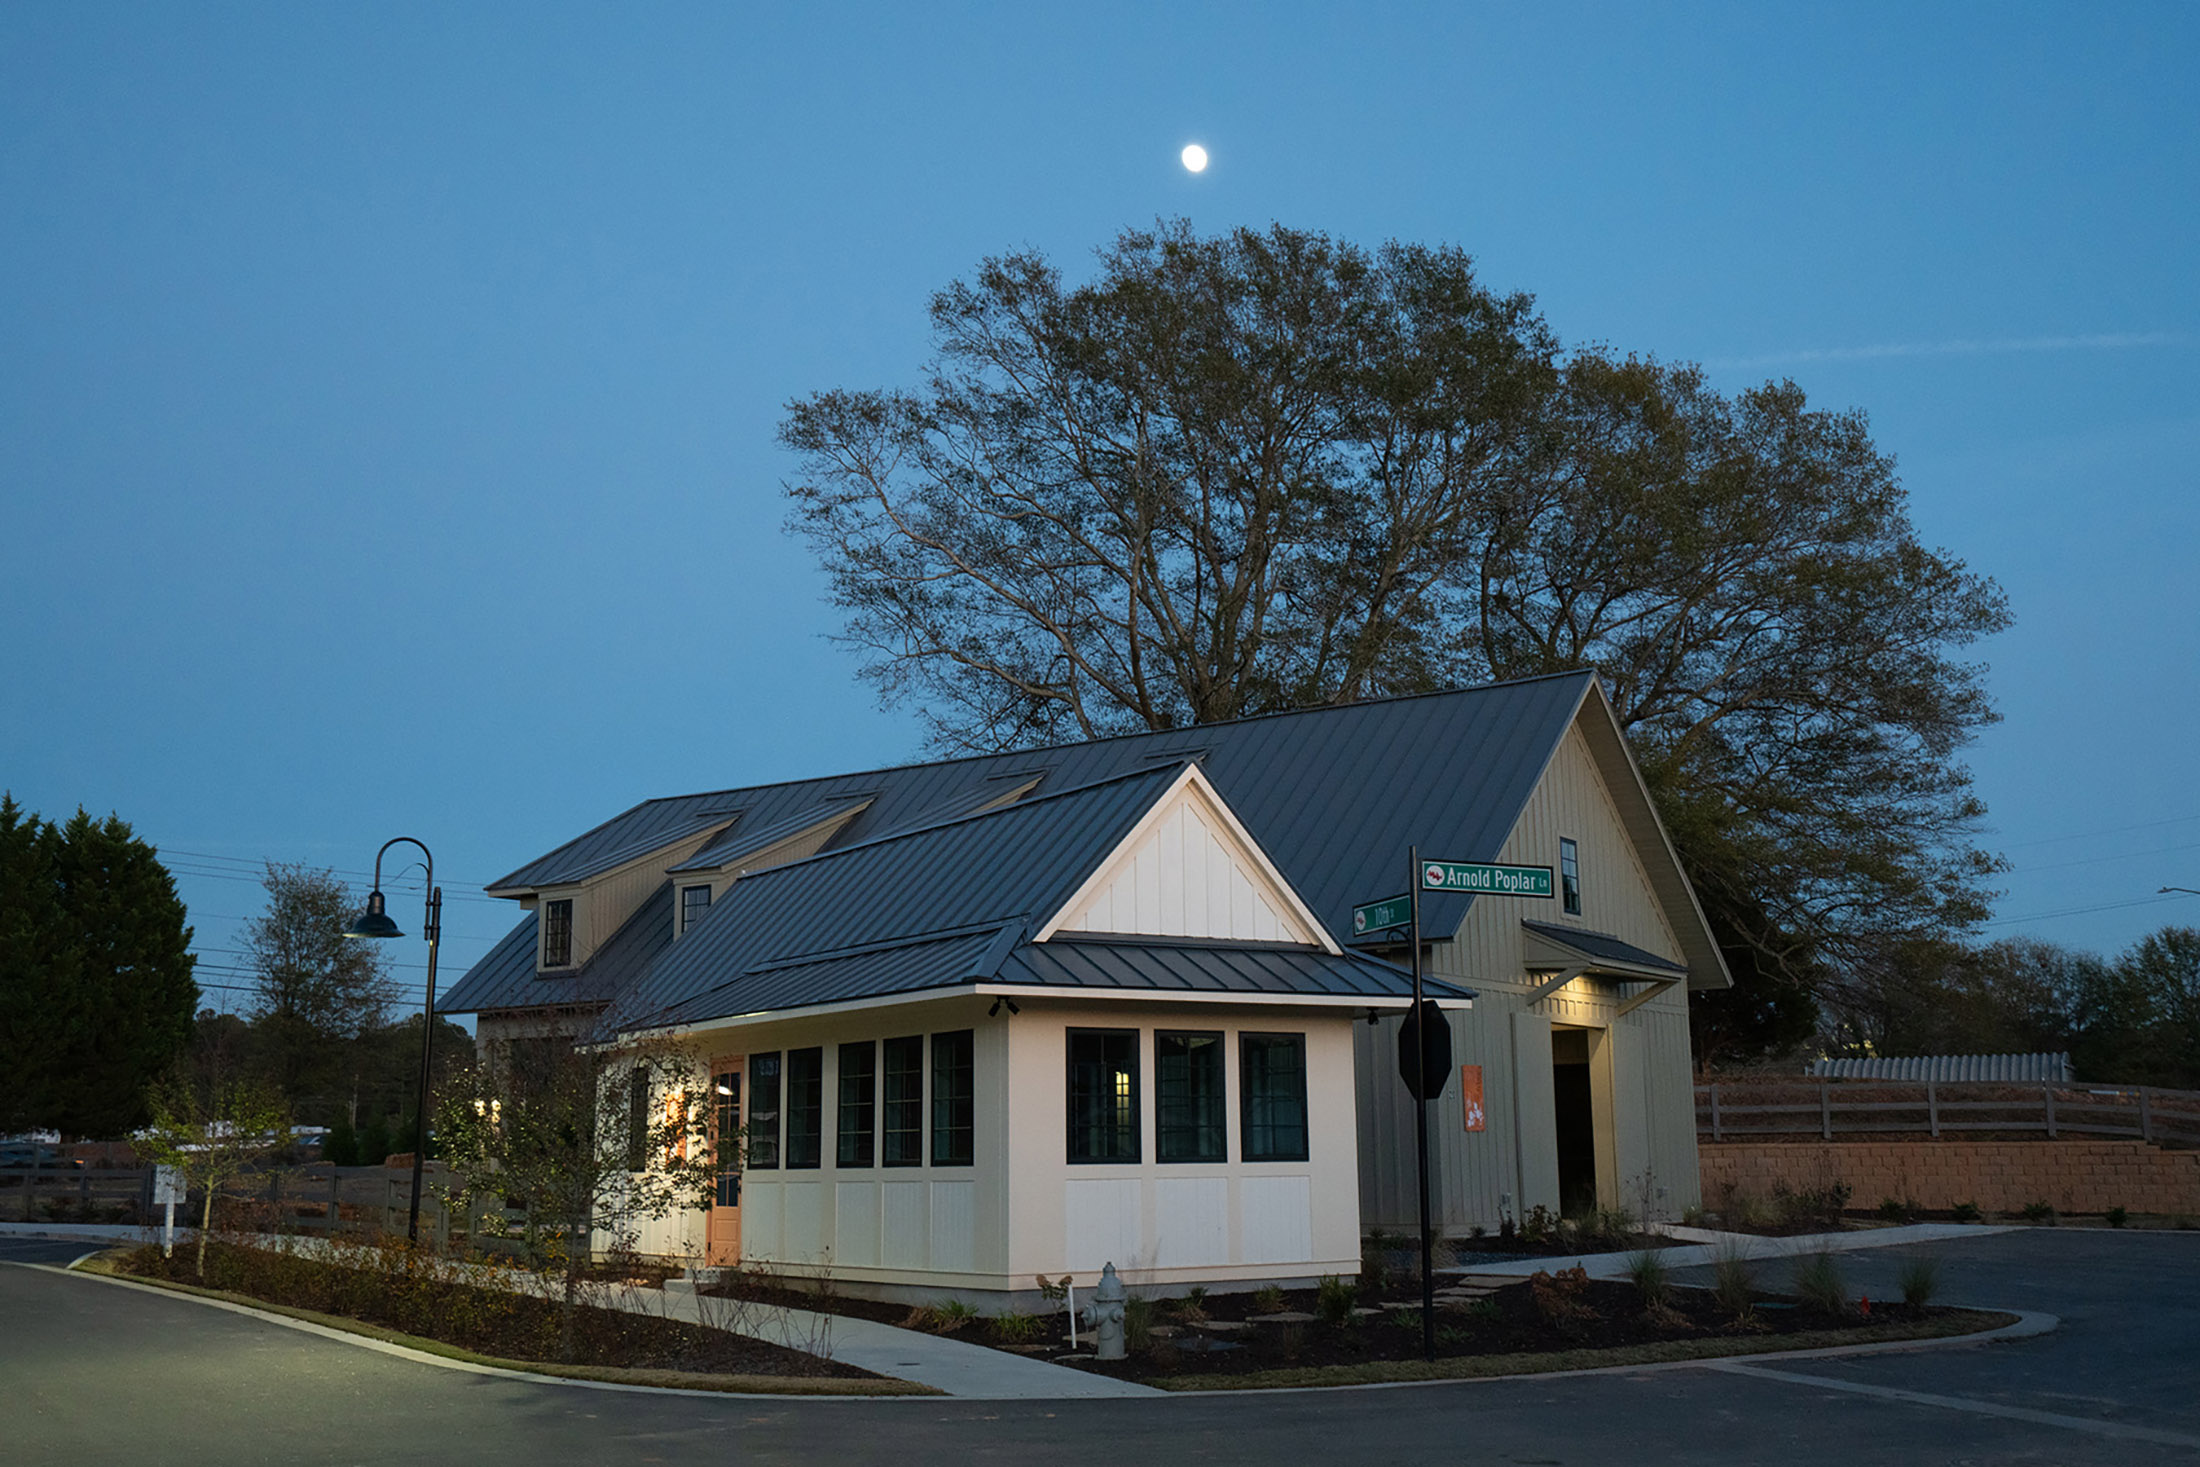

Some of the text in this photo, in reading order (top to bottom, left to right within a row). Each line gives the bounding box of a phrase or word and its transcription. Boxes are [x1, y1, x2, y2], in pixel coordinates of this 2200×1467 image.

[1447, 867, 1548, 892] Arnold Poplar Ln
[1374, 906, 1390, 926] 10th
